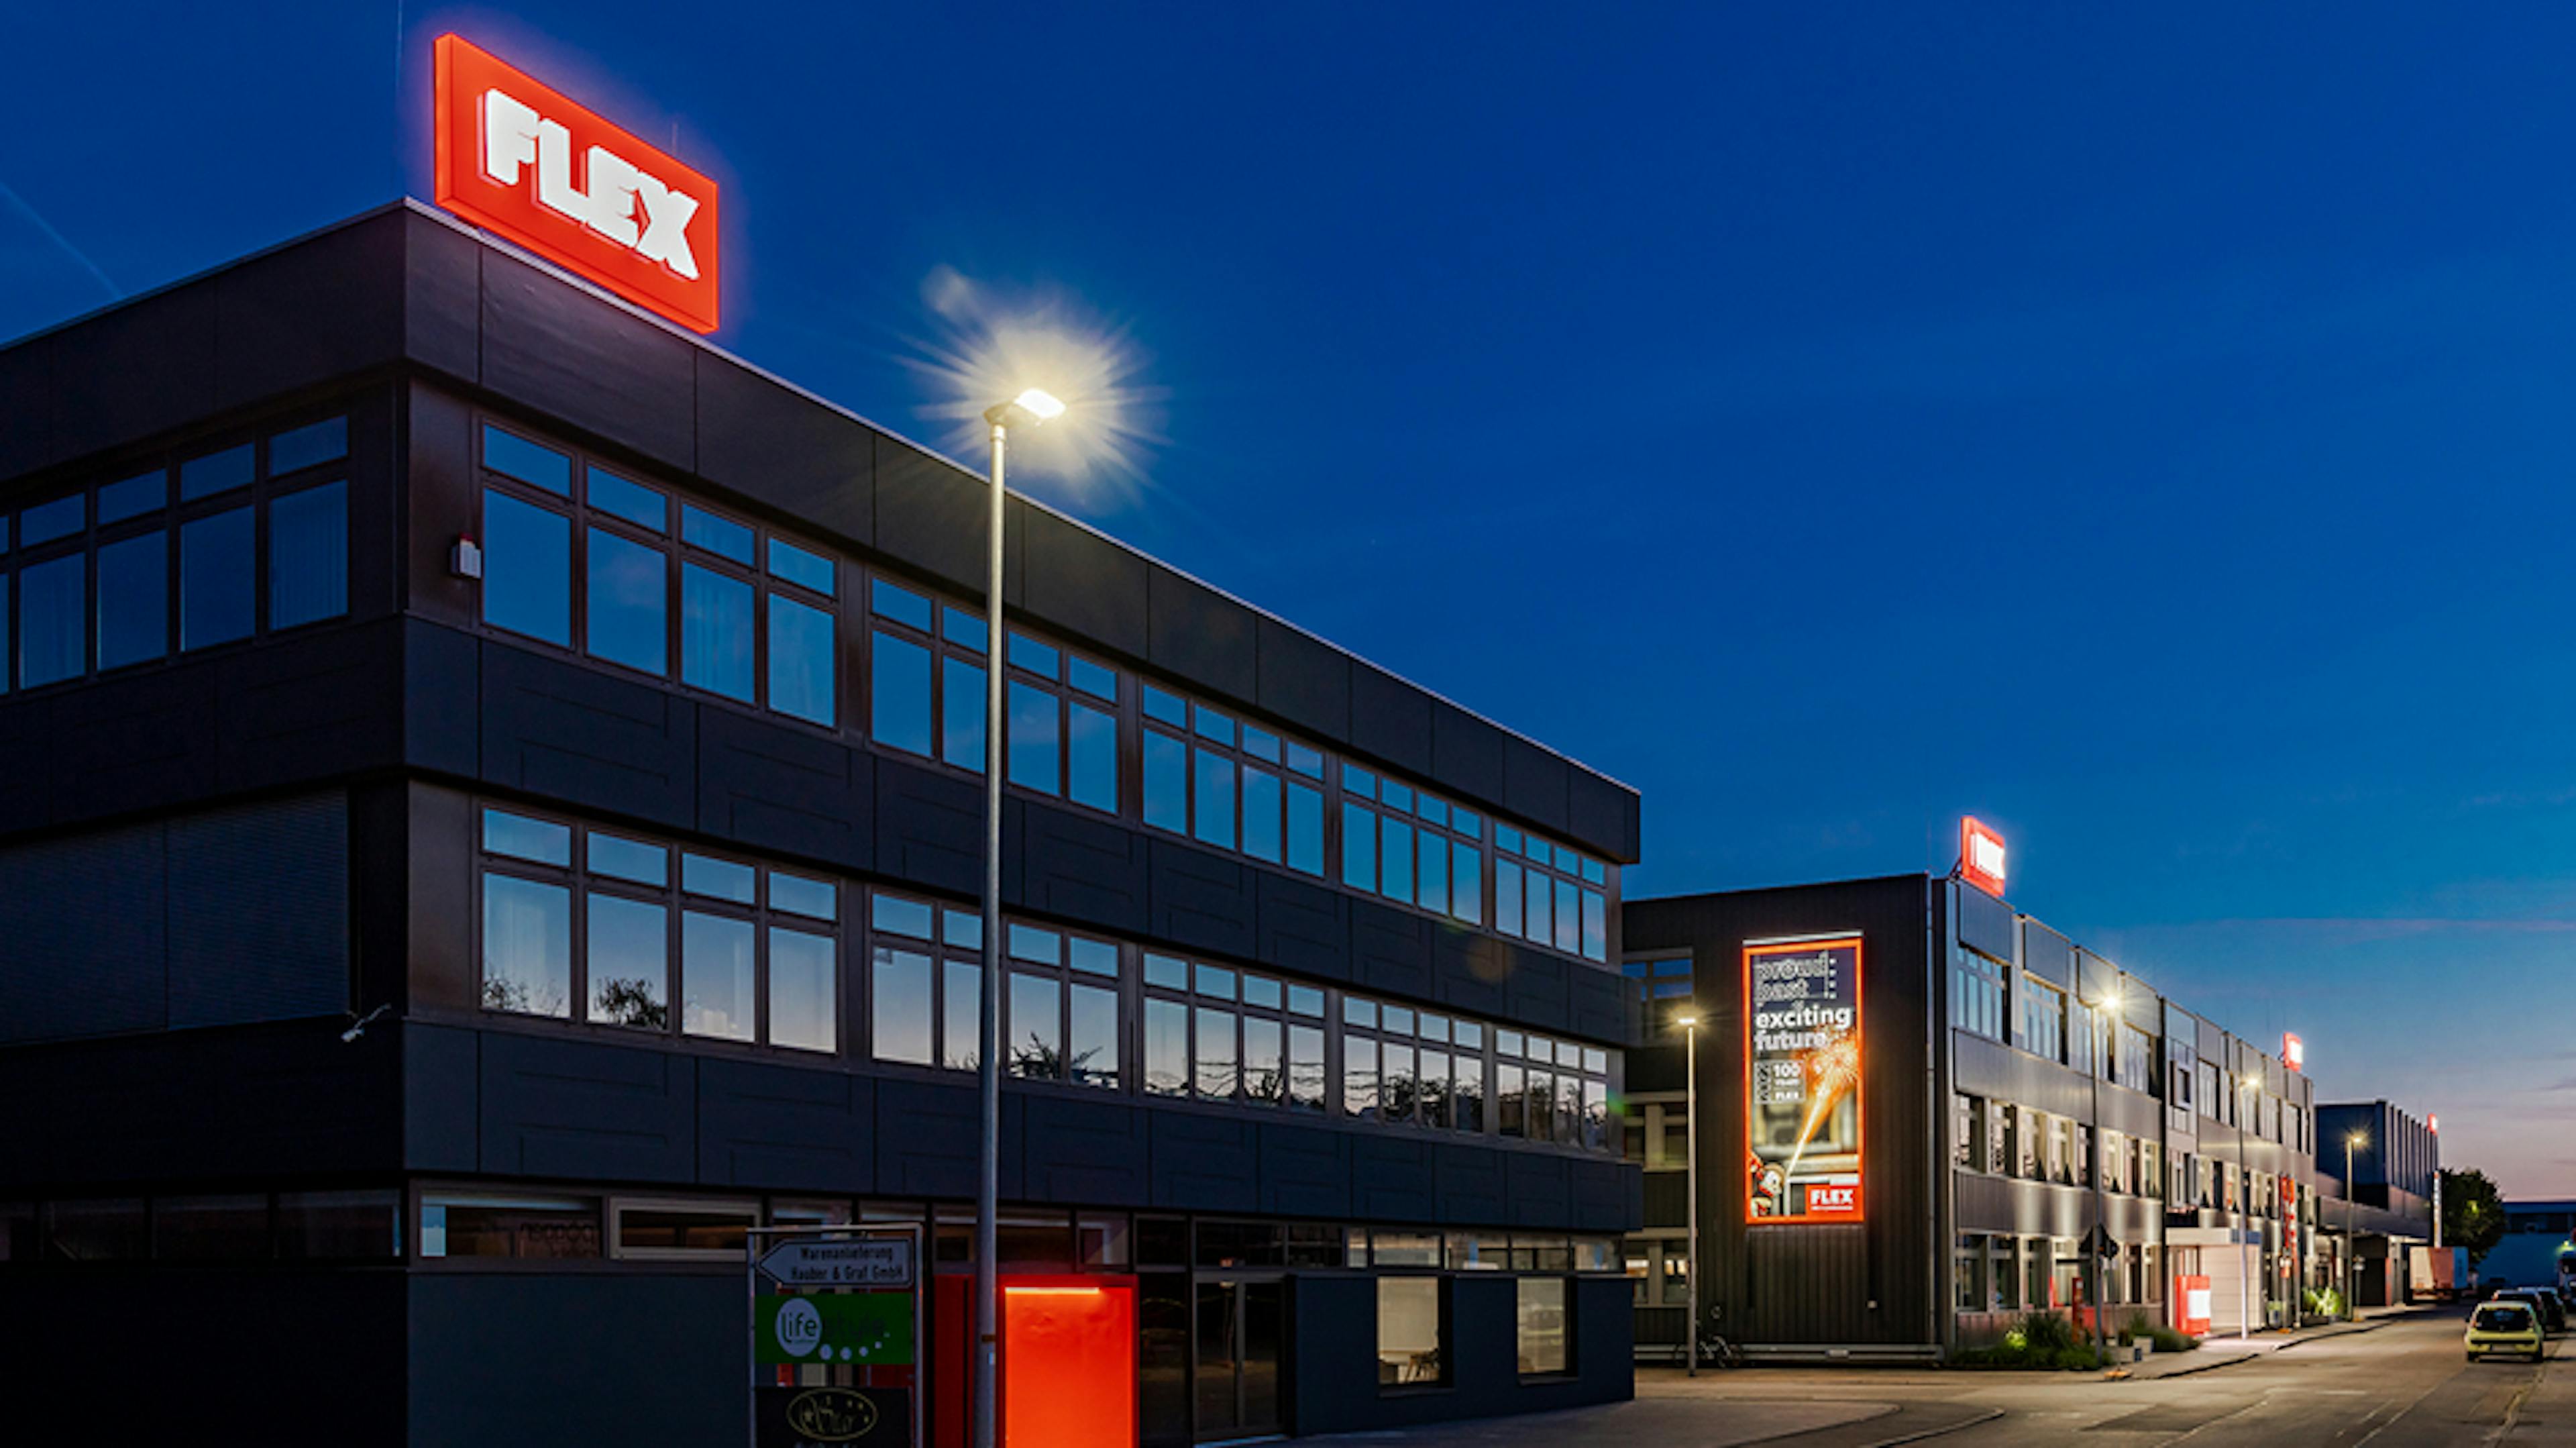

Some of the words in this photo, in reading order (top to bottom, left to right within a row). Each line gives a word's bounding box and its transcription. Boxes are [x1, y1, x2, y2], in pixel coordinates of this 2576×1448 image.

[479, 88, 700, 282] FLEX
[1756, 1004, 1851, 1030] exciting
[1773, 1062, 1801, 1078] 100
[1810, 1188, 1854, 1206] FLEX
[801, 1246, 893, 1262] Warenanlieferung
[833, 1265, 841, 1280] &
[844, 1264, 868, 1280] Graf
